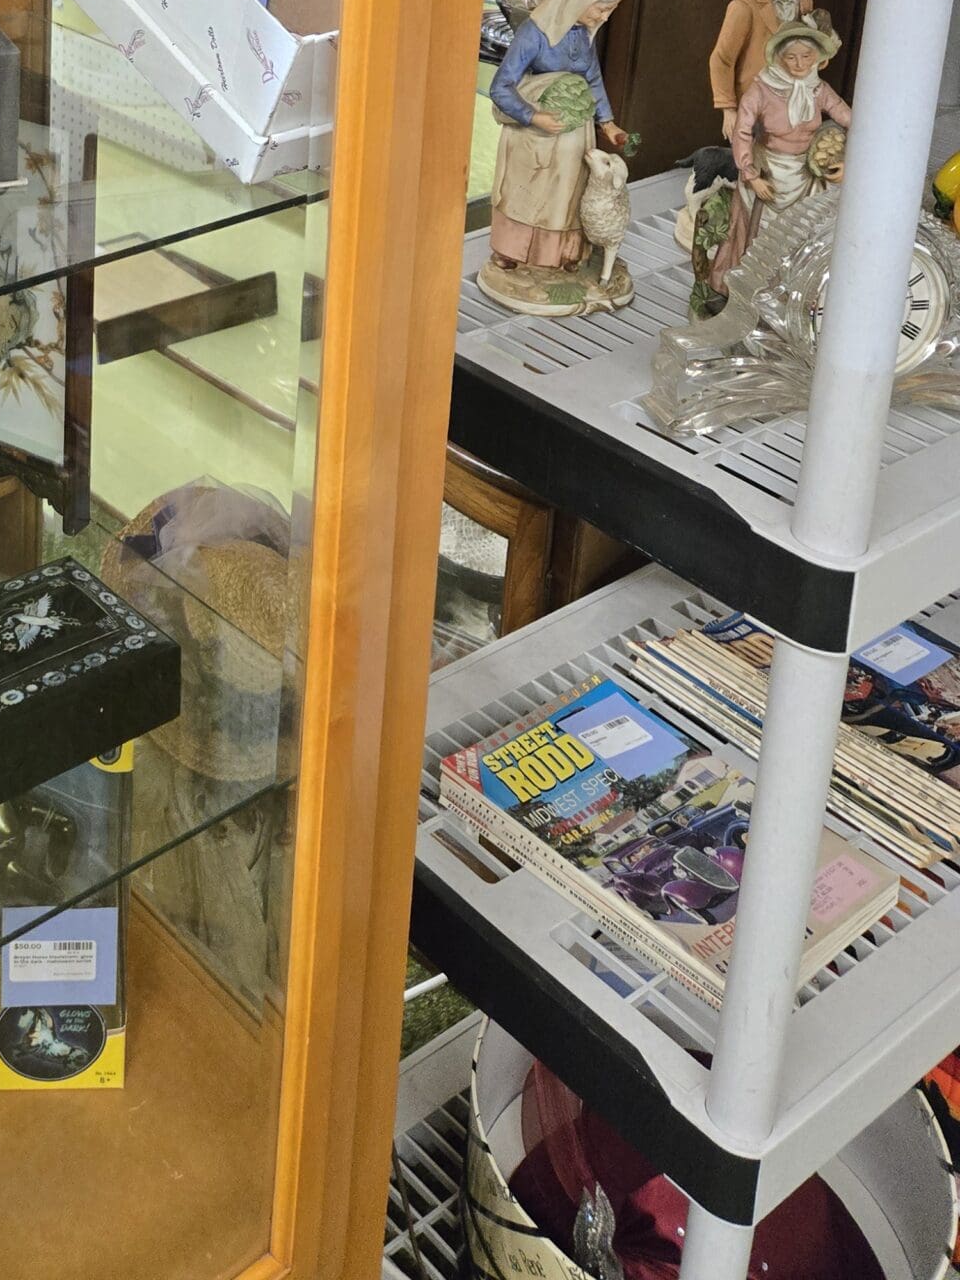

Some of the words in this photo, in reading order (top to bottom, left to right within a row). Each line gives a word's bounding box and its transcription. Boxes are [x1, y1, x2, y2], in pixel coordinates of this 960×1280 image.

[910, 300, 929, 311] III
[482, 721, 560, 773] STREET
[522, 791, 580, 829] MIDWEST
[561, 828, 581, 846] CAR
[59, 1009, 91, 1018] GLOWS
[60, 1024, 91, 1033] DARK!
